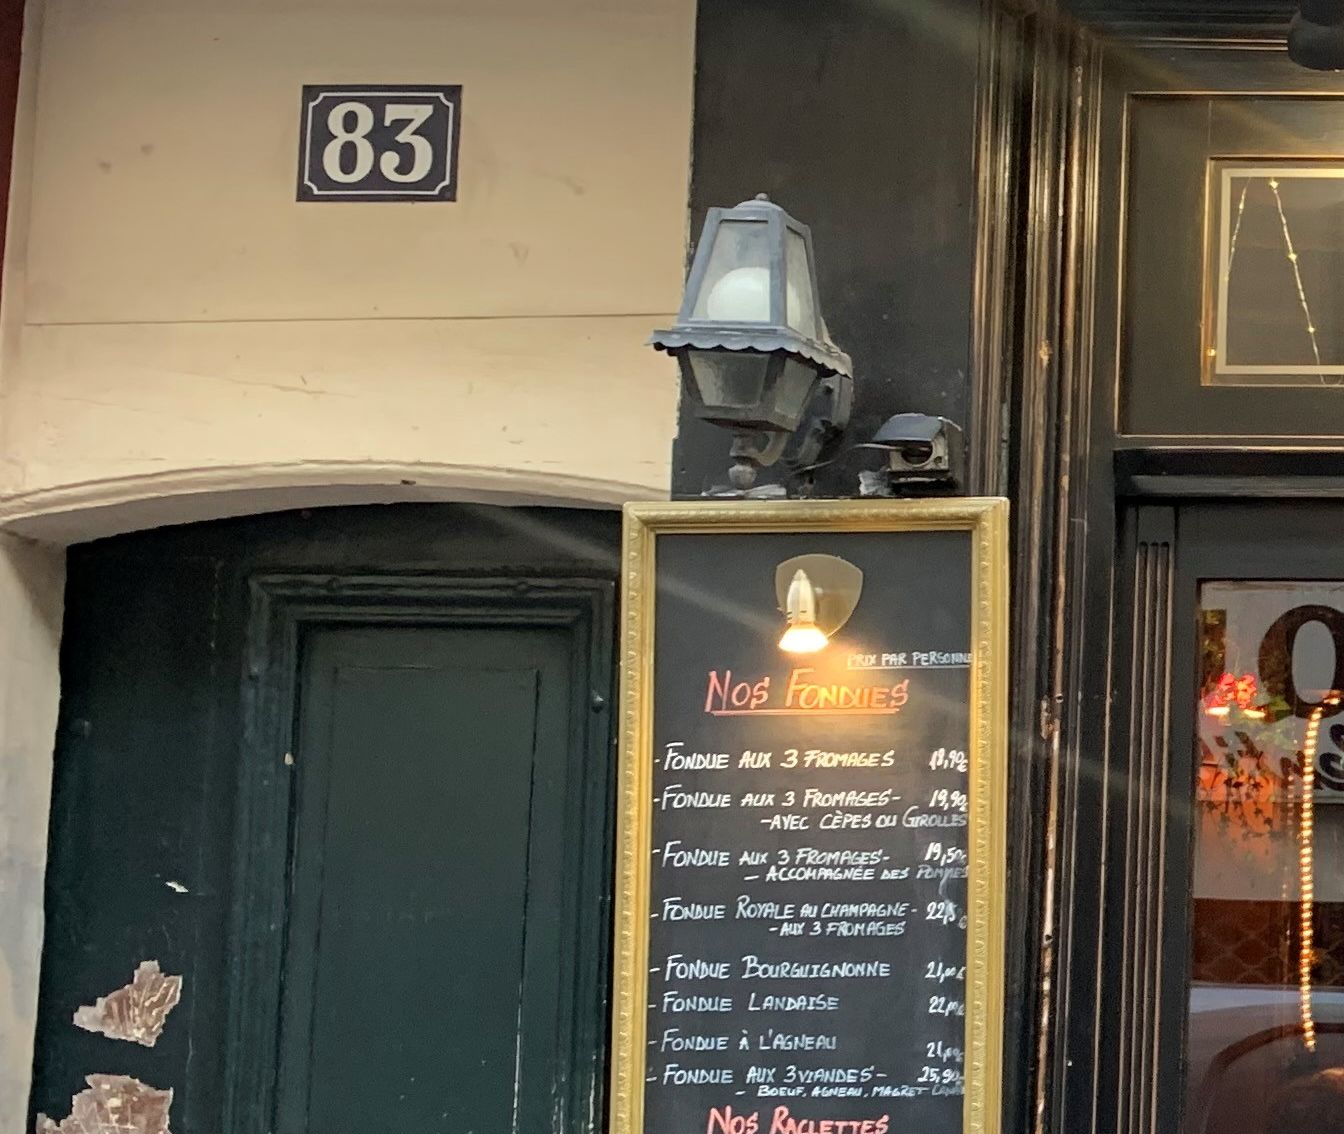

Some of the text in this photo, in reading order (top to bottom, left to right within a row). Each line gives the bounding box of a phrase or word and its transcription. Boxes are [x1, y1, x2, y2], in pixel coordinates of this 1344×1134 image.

[322, 102, 433, 183] 83
[664, 742, 894, 770] FONDUE AUX 3 FROMAGES
